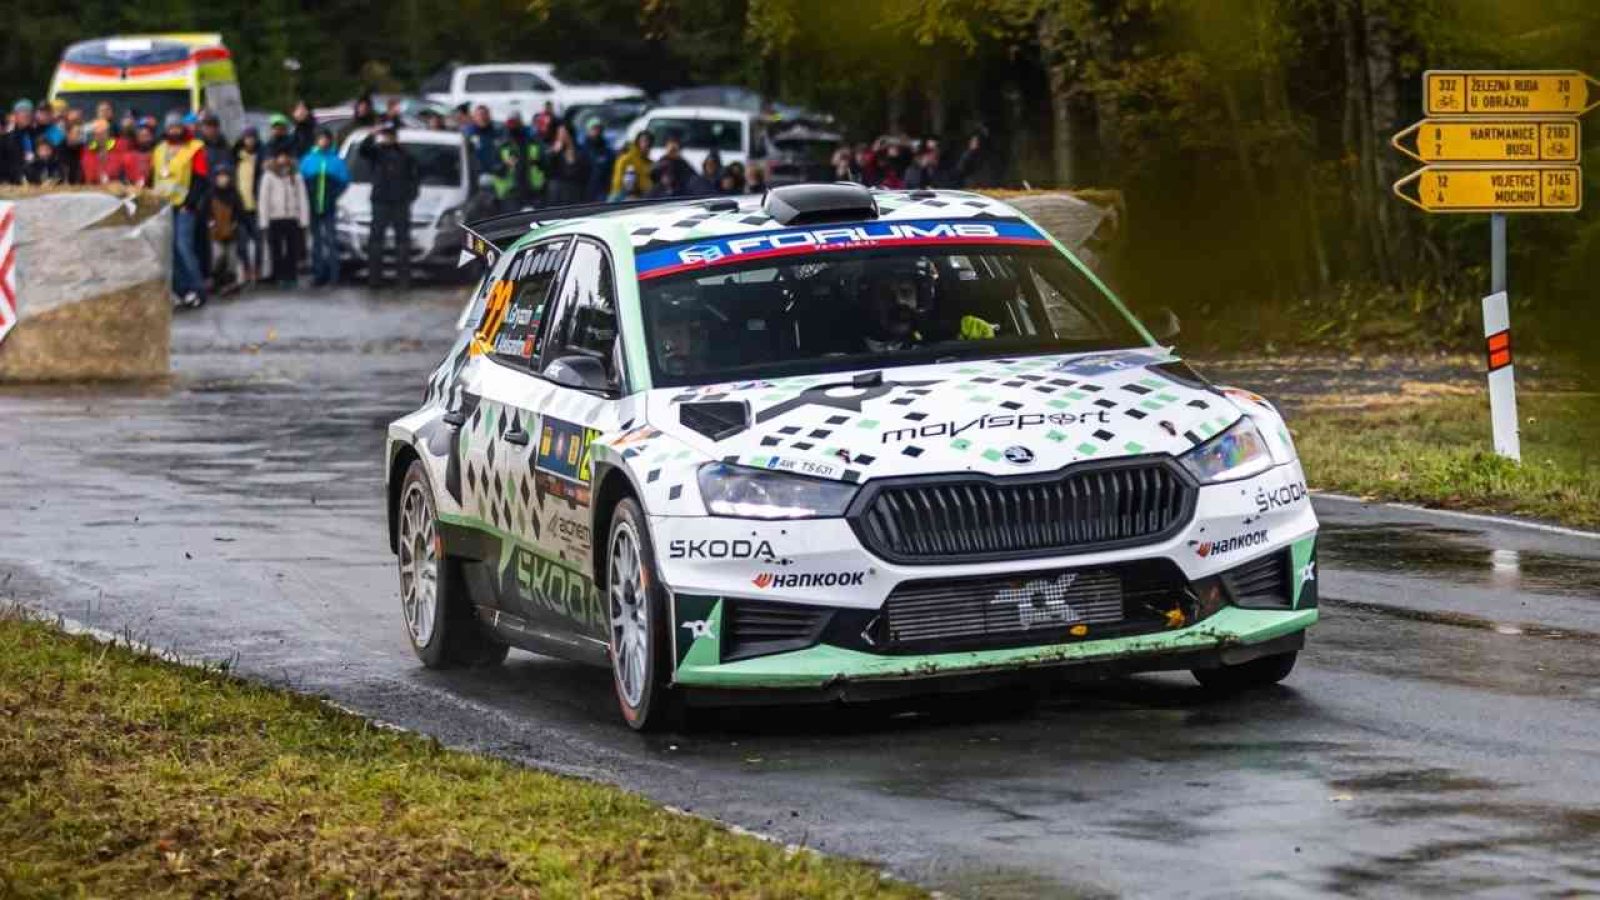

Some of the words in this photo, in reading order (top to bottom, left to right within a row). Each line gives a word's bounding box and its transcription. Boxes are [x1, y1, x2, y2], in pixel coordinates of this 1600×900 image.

[1515, 80, 1539, 91] RUDA
[1470, 95, 1478, 107] U
[1470, 128, 1534, 140] HARTMANICE
[1491, 174, 1535, 187] VOJETICE
[1495, 190, 1536, 203] MOCHOV
[728, 223, 998, 254] FORUM8
[882, 409, 1111, 444] movisport
